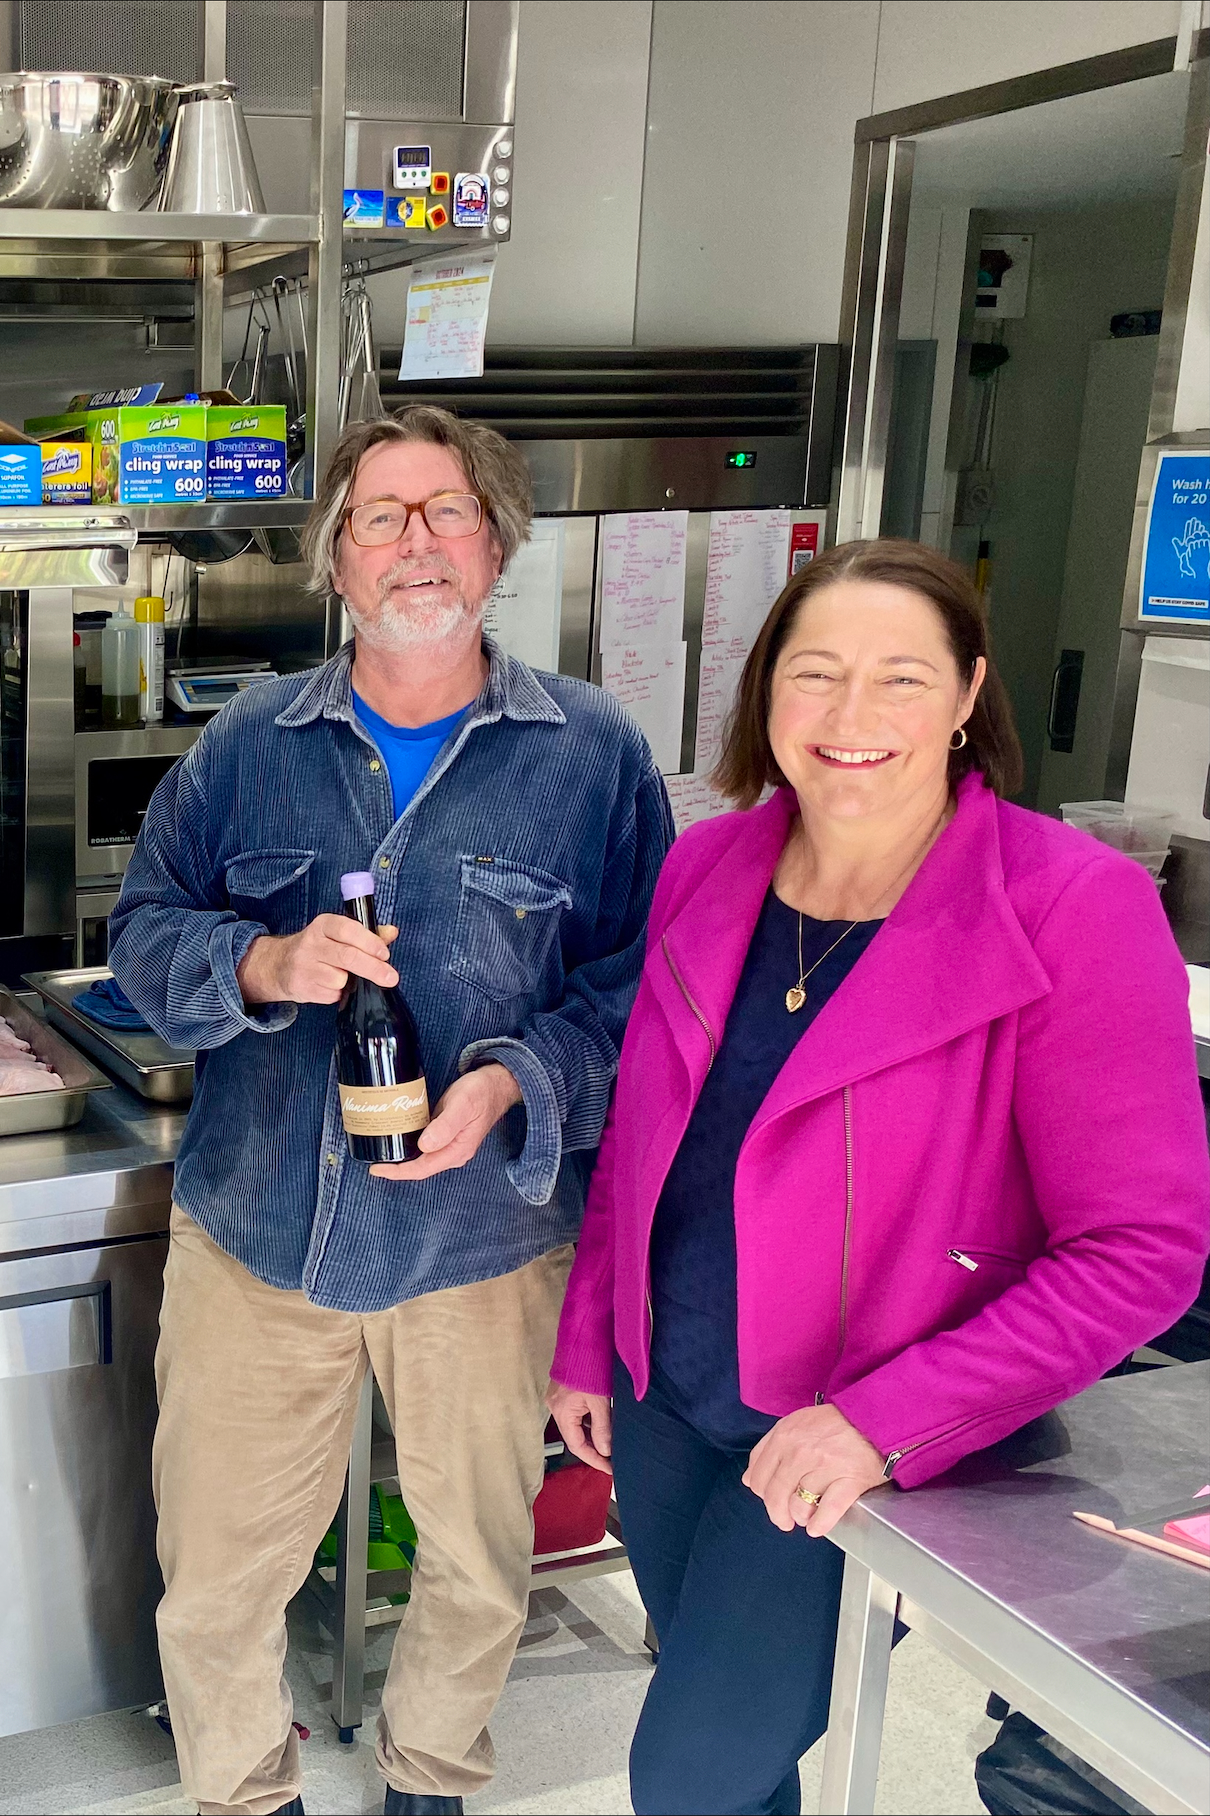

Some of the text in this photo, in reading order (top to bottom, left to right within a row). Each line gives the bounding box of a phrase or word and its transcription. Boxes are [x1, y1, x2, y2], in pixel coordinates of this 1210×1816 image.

[101, 420, 115, 438] 600
[125, 456, 203, 474] cling wrap
[208, 456, 281, 472] cling wrap
[72, 482, 87, 490] foil
[175, 478, 203, 492] 600
[255, 475, 282, 489] 600
[1172, 479, 1202, 490] Wash
[1172, 493, 1207, 504] for 20
[342, 1088, 426, 1112] Nanima Road
